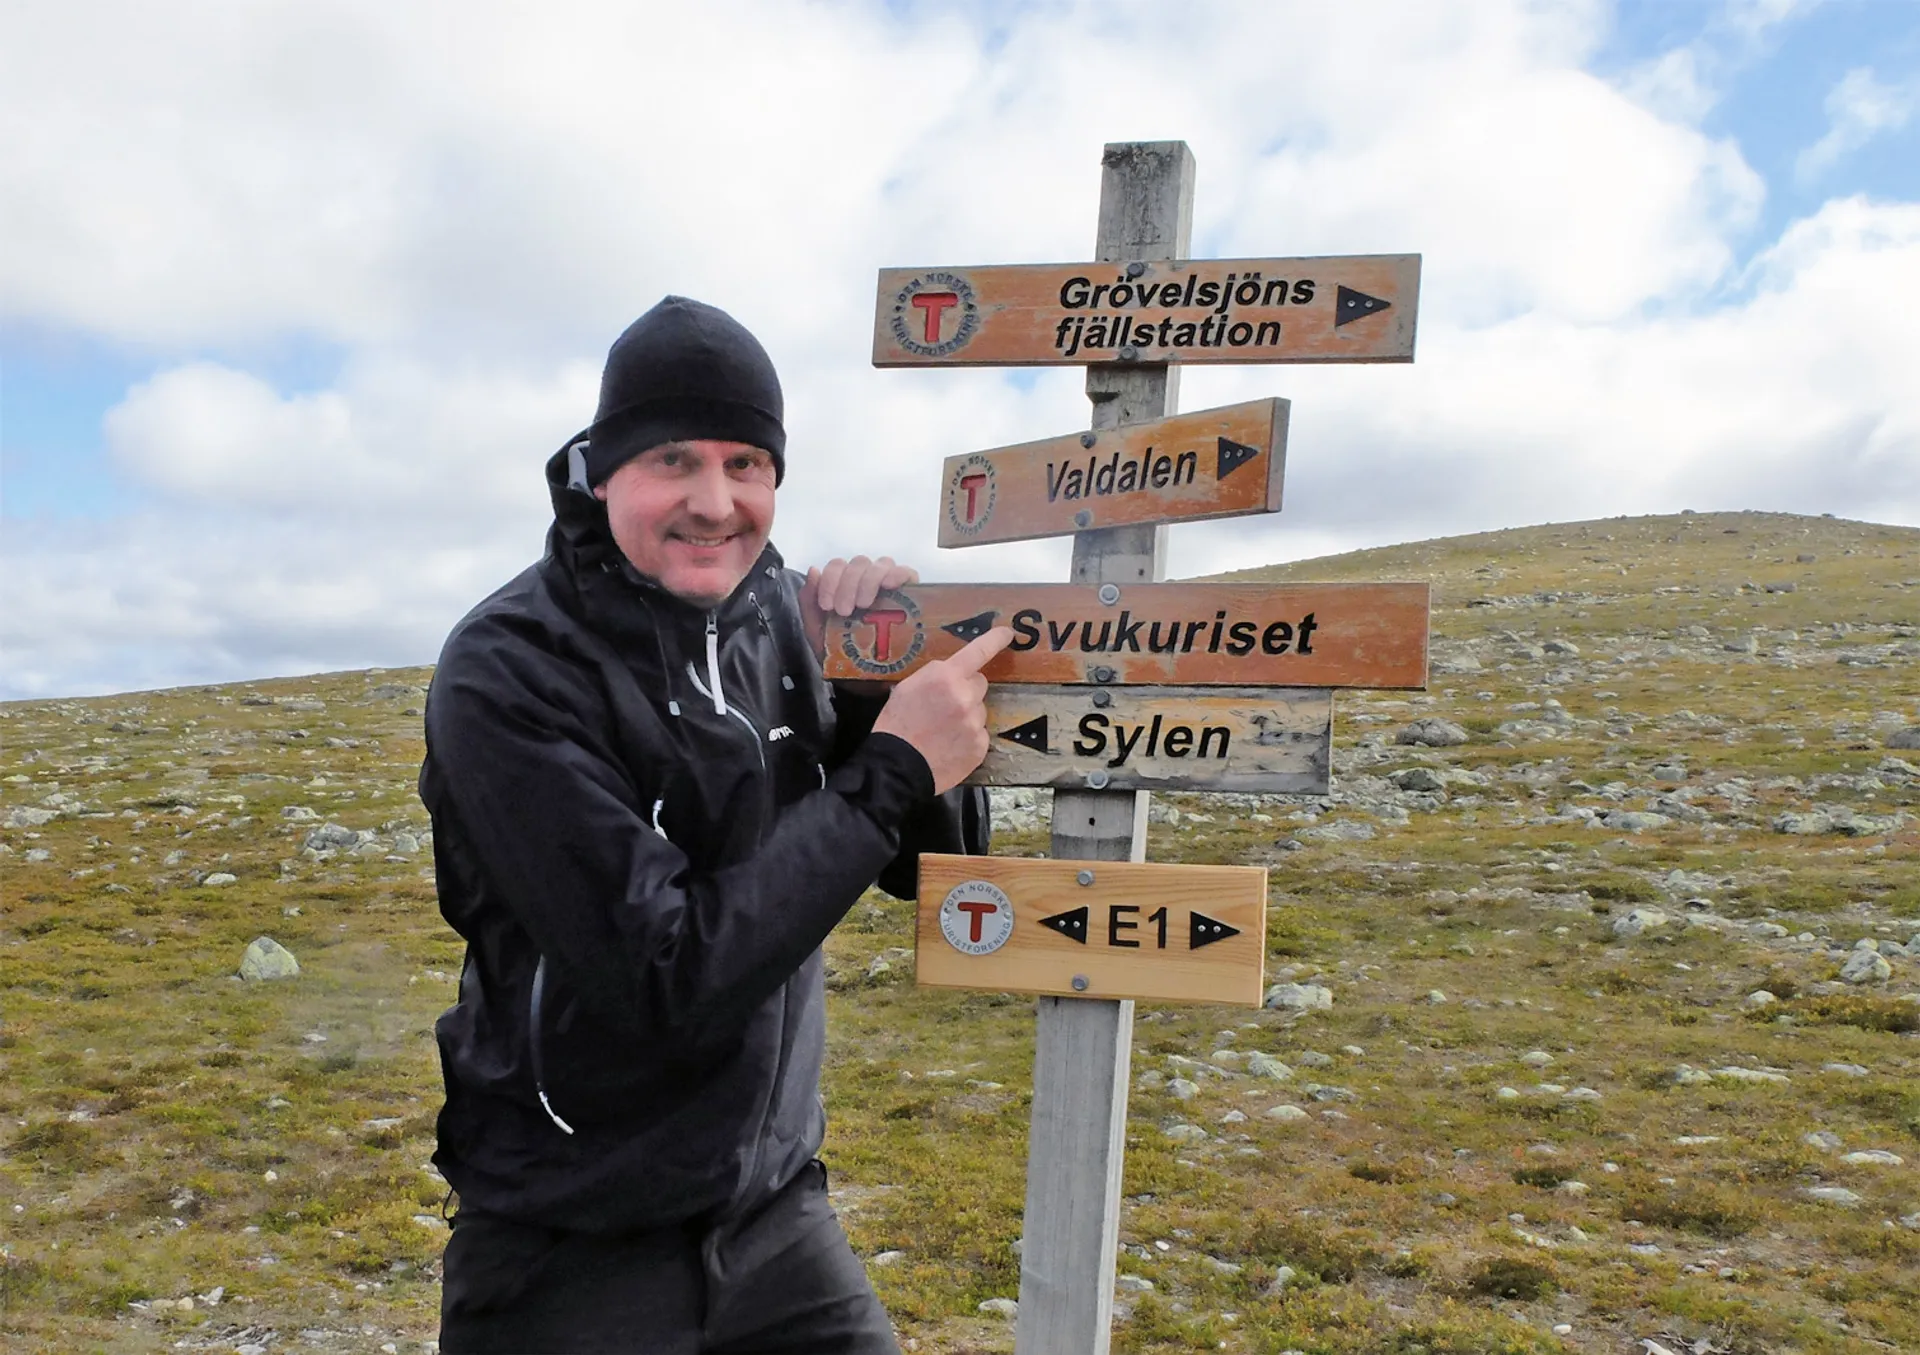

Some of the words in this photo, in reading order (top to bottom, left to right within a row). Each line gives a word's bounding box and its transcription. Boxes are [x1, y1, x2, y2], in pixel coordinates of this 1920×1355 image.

[1059, 272, 1316, 313] Grövelsjöns
[911, 292, 959, 344] T
[1055, 313, 1281, 355] fjällstation
[1046, 447, 1198, 503] Valdalen
[960, 473, 987, 524] T
[863, 609, 907, 661] T
[1009, 608, 1319, 655] Svukuriset
[1072, 713, 1232, 769] Sylen
[946, 887, 965, 907] DEN
[968, 883, 1010, 911] NORSKE
[943, 916, 1011, 953] TURISTFORENING
[957, 901, 998, 944] T
[1108, 904, 1168, 949] E1
